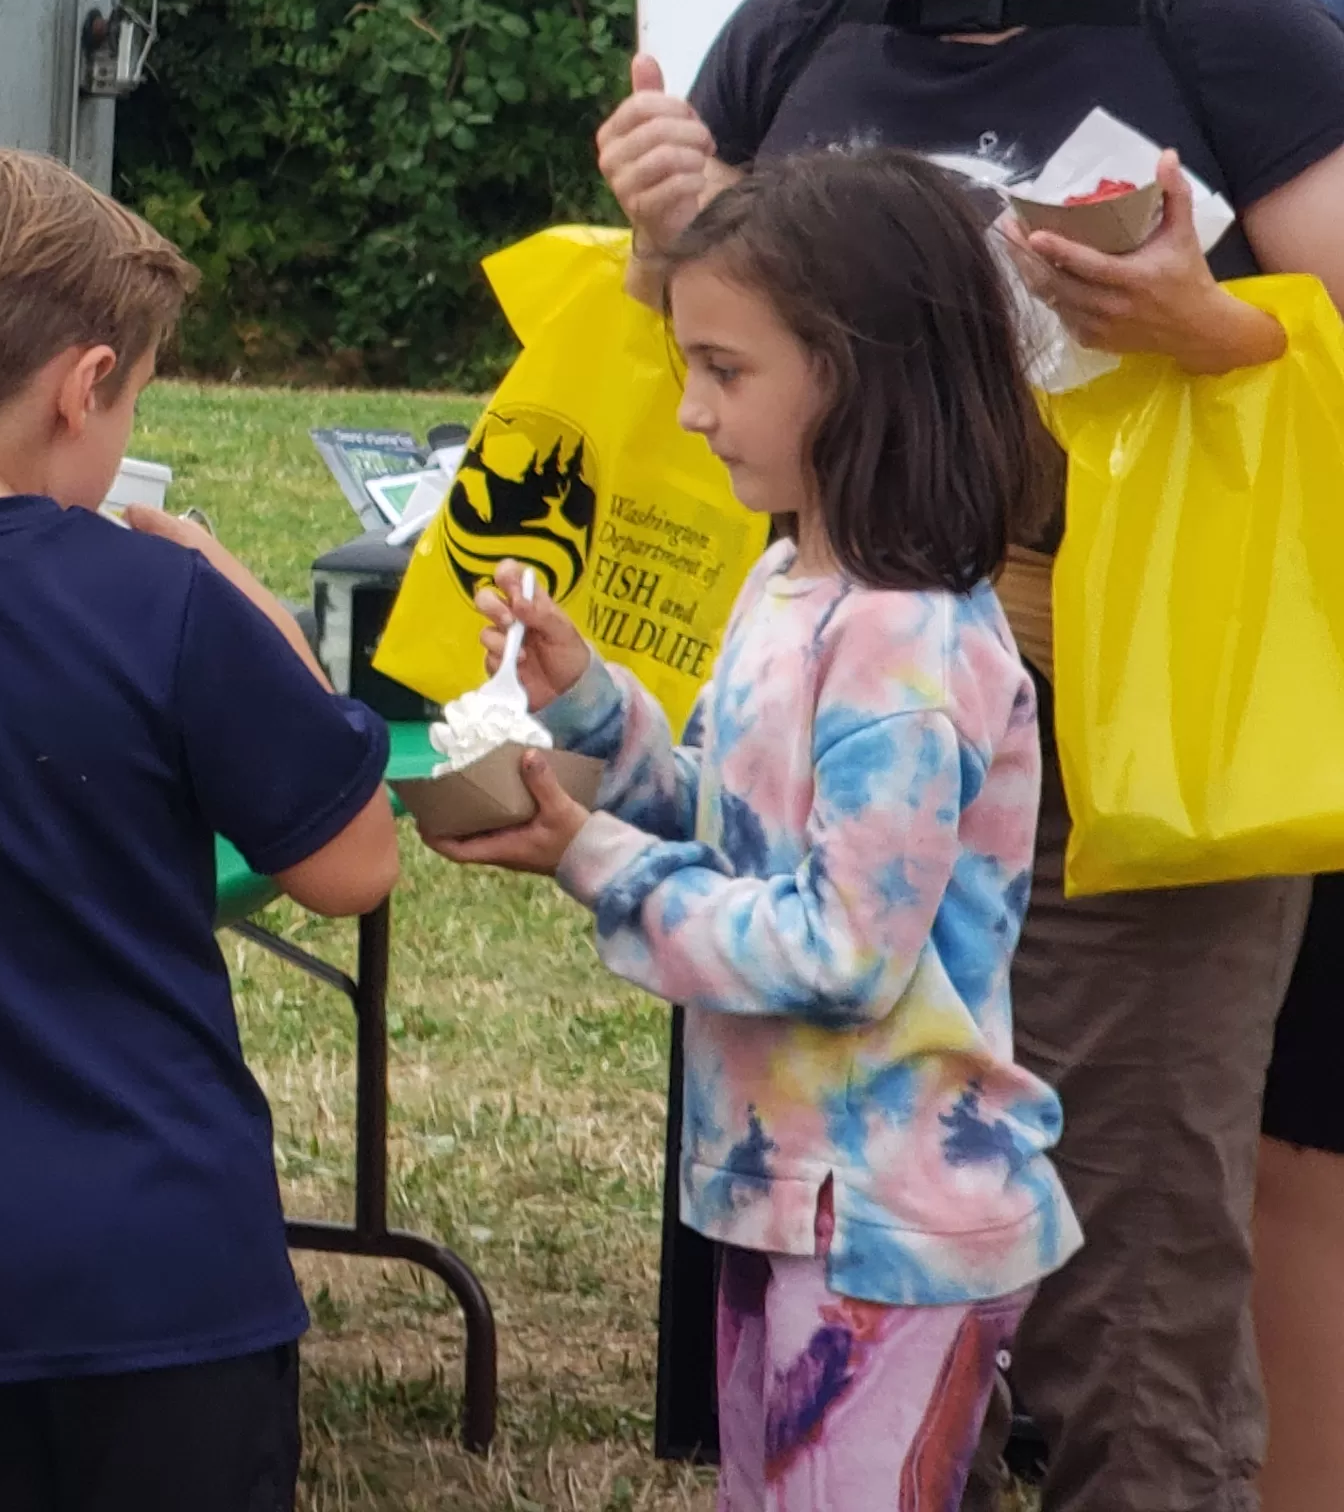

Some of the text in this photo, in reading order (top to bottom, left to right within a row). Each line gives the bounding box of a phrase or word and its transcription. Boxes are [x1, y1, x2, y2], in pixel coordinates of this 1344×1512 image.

[599, 520, 702, 576] Department
[610, 494, 710, 549] Washington
[593, 554, 699, 626] FISH and
[587, 595, 712, 680] WILDLIFE
